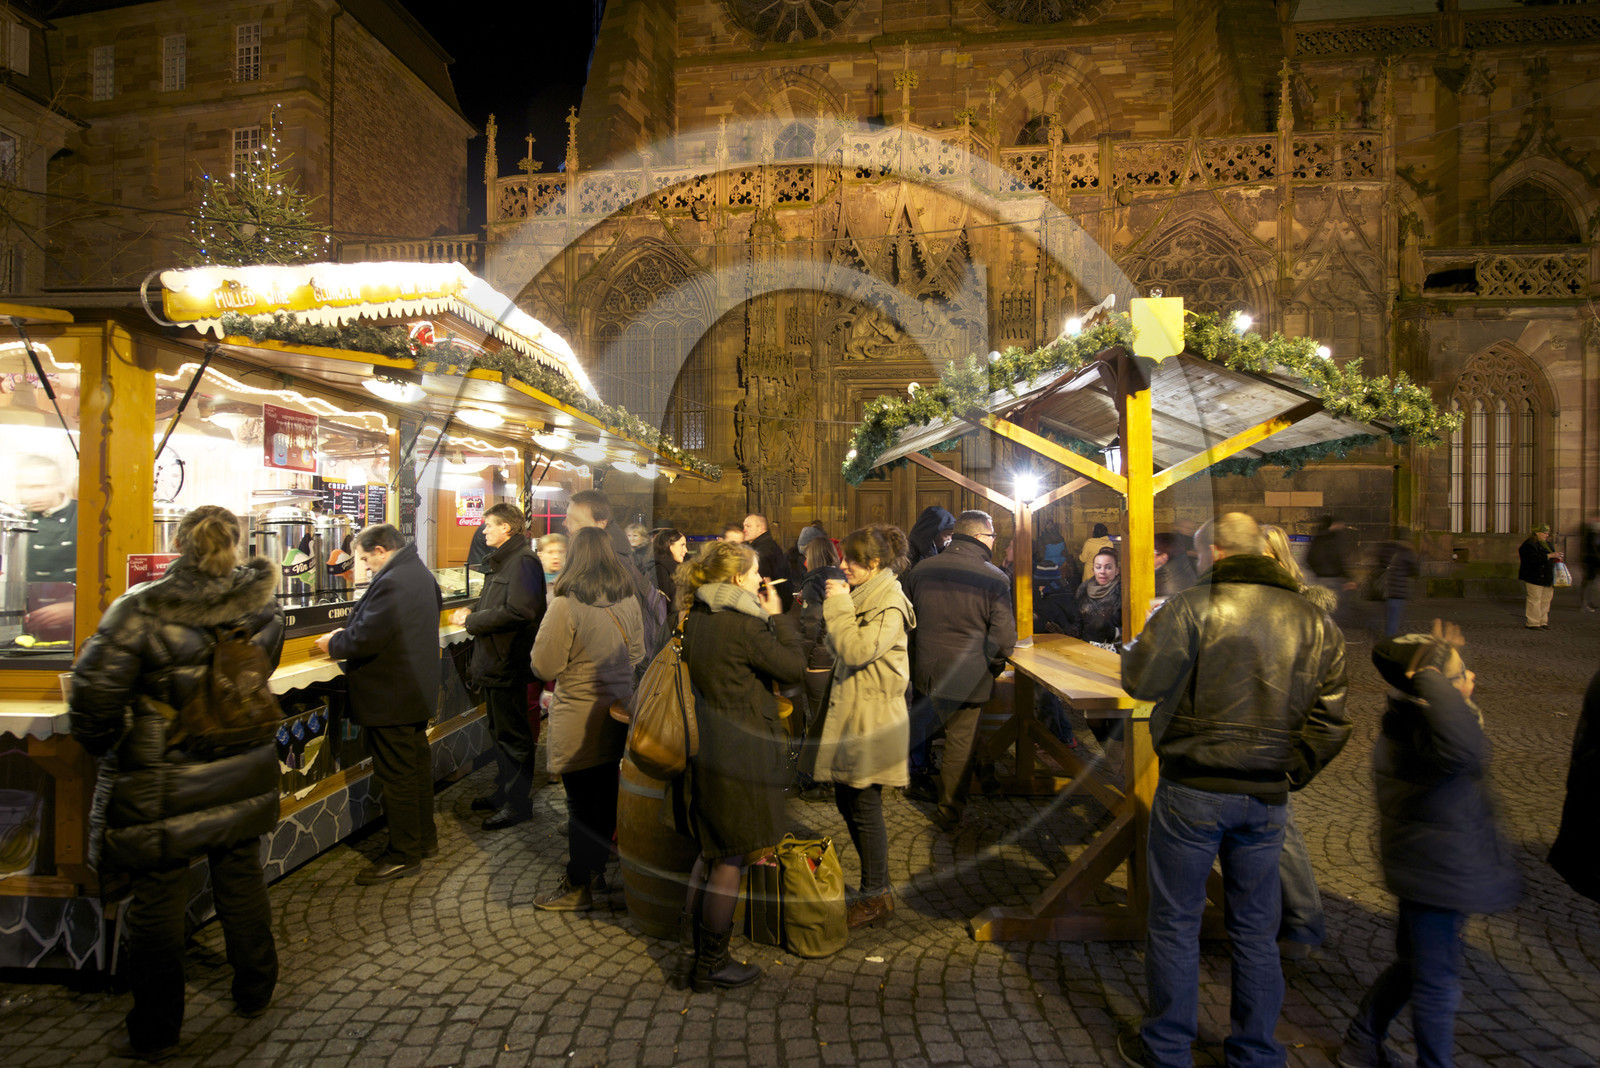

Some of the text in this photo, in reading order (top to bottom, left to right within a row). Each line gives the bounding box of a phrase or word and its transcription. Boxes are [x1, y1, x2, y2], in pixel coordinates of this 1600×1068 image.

[214, 290, 256, 308] MULLED
[264, 288, 290, 305] WINE
[292, 562, 308, 574] Vin
